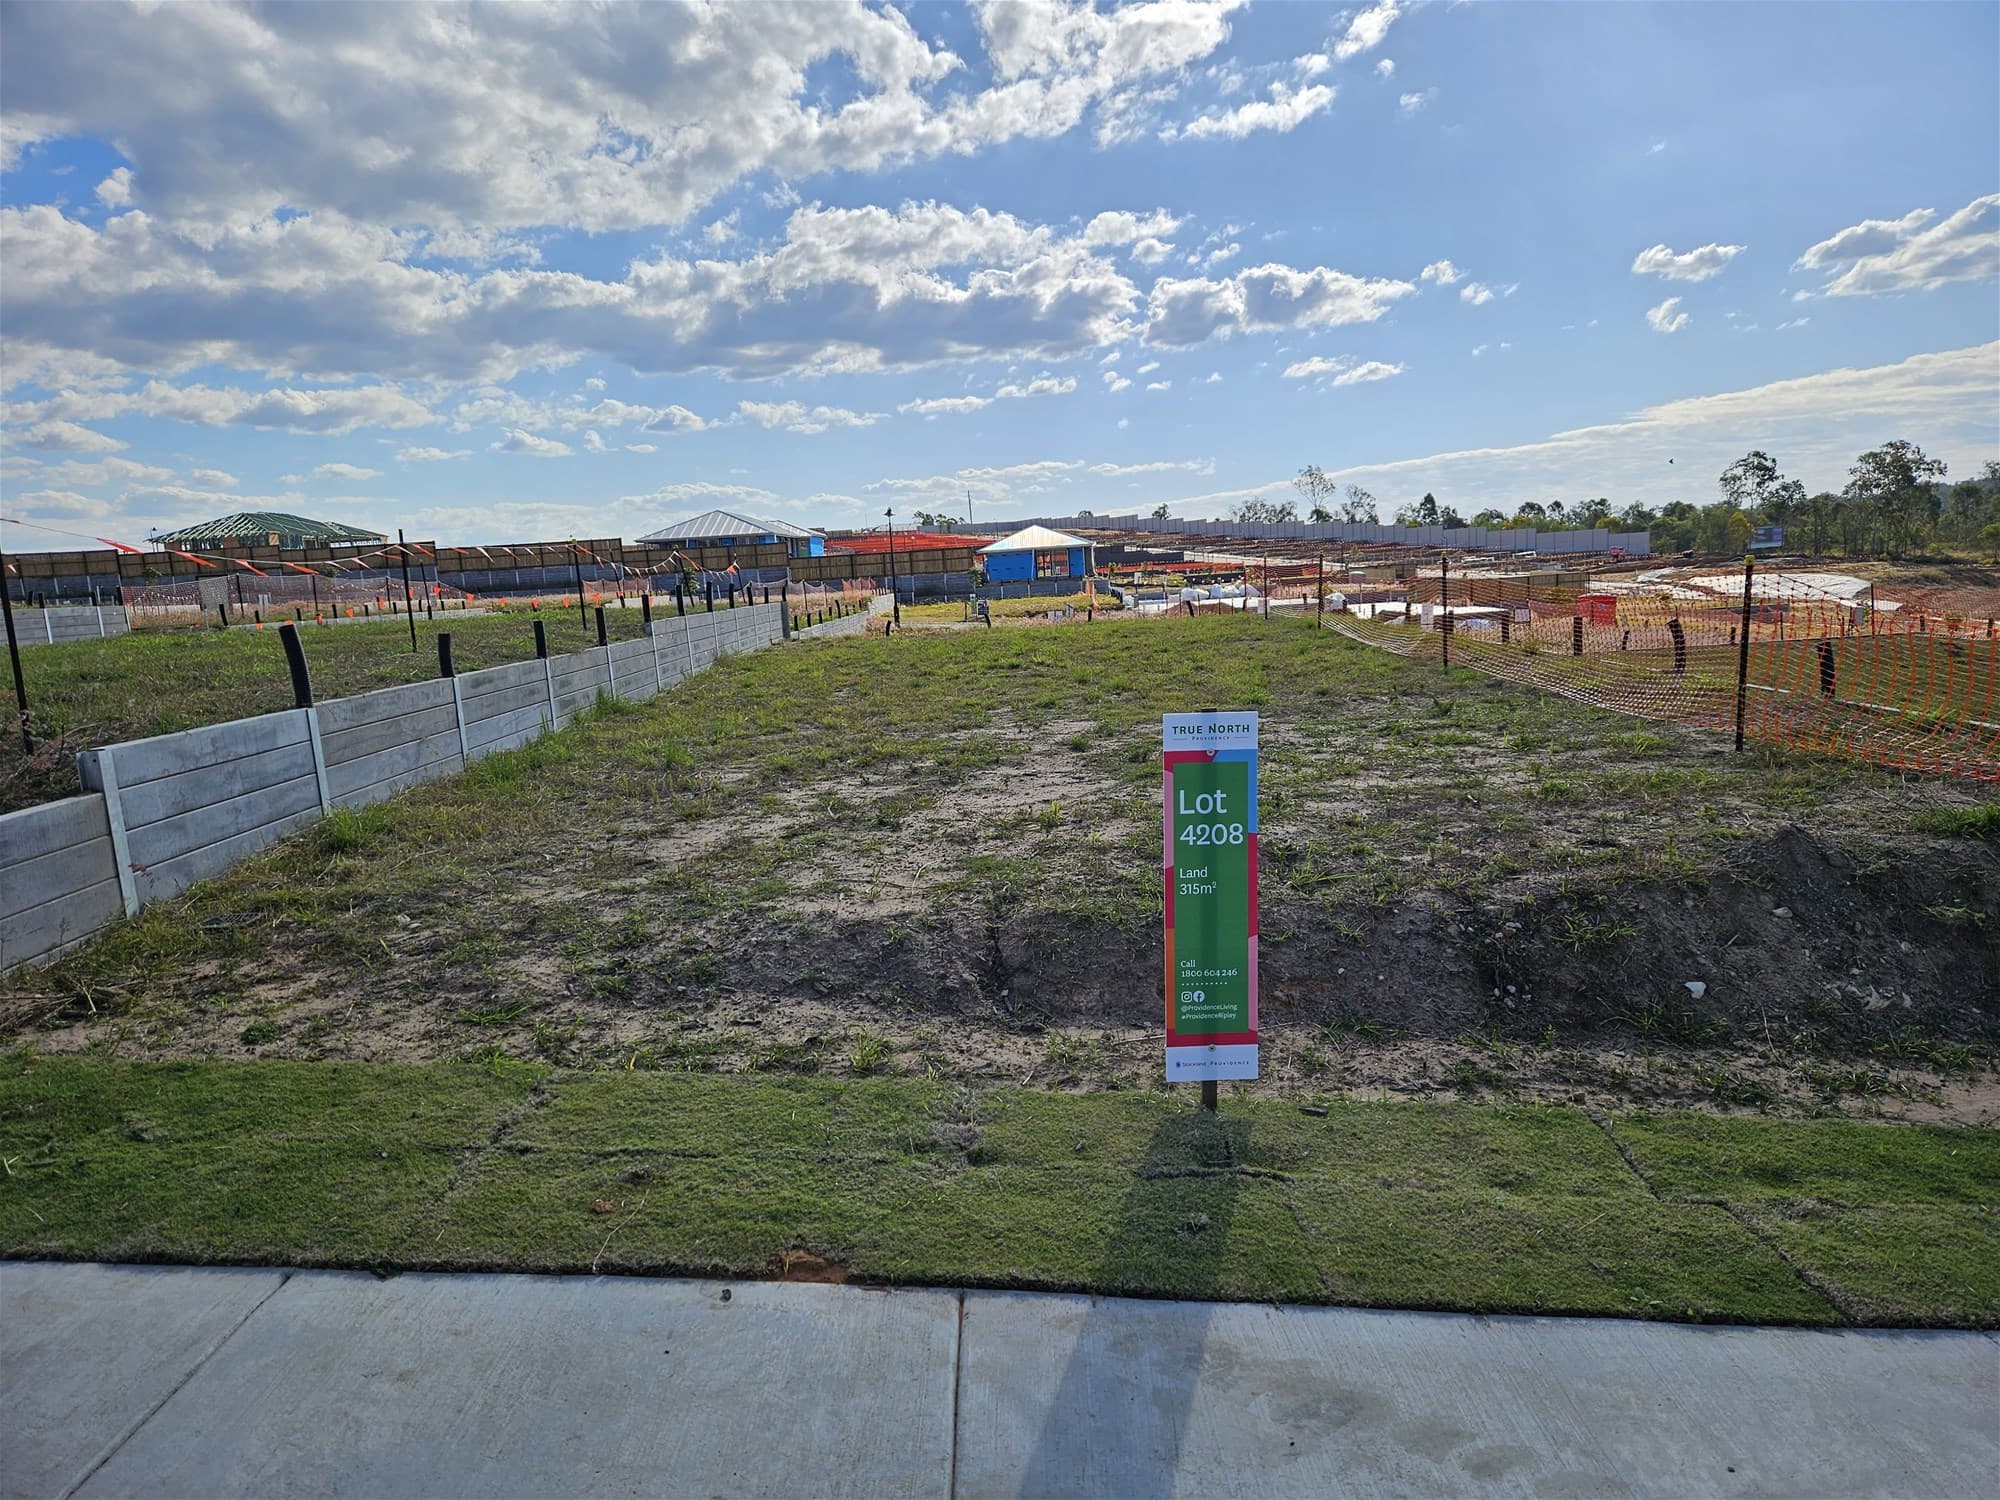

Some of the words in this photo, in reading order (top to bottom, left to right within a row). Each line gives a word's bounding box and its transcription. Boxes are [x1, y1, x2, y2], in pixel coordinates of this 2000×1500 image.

[1172, 725, 1203, 735] TRUE
[1208, 723, 1250, 734] NORTH
[1179, 789, 1227, 815] Lot
[1179, 823, 1244, 845] 4208
[1179, 866, 1208, 878] Land
[1179, 881, 1217, 895] 315m²
[1180, 959, 1196, 968] Call
[1181, 969, 1202, 978] 1800
[1203, 968, 1220, 977] 604
[1221, 967, 1238, 976] 246
